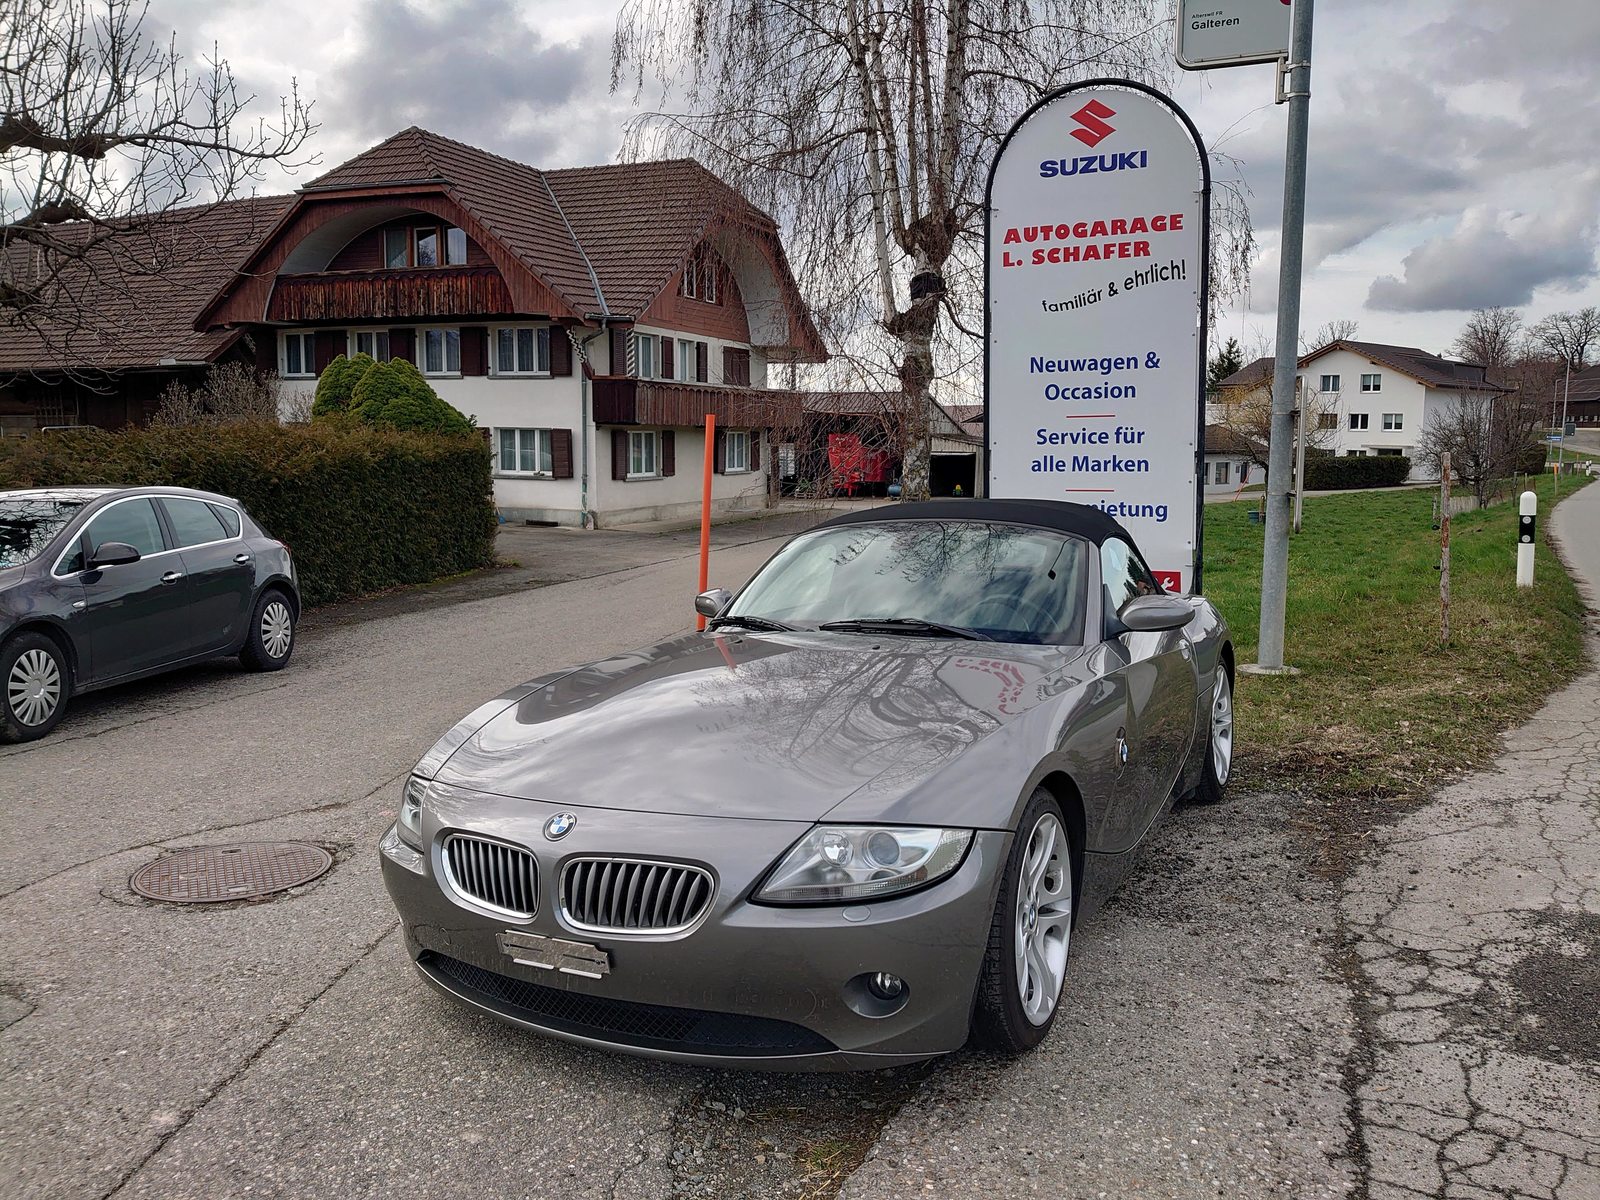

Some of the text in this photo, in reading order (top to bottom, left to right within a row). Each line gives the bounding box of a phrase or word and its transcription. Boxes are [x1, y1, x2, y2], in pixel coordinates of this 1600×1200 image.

[1192, 17, 1240, 30] Galteren
[1040, 150, 1147, 178] SUZUKI
[1003, 214, 1184, 245] AUTOGARAGE
[1002, 240, 1151, 268] L. SCHAFER
[1042, 259, 1187, 312] familiär & ehrlich!
[1030, 351, 1161, 375] Neuwagen &
[1044, 382, 1136, 401] Occasion
[1036, 426, 1145, 446] Service für
[1031, 454, 1150, 473] alle Marken
[1087, 499, 1168, 522] ietung
